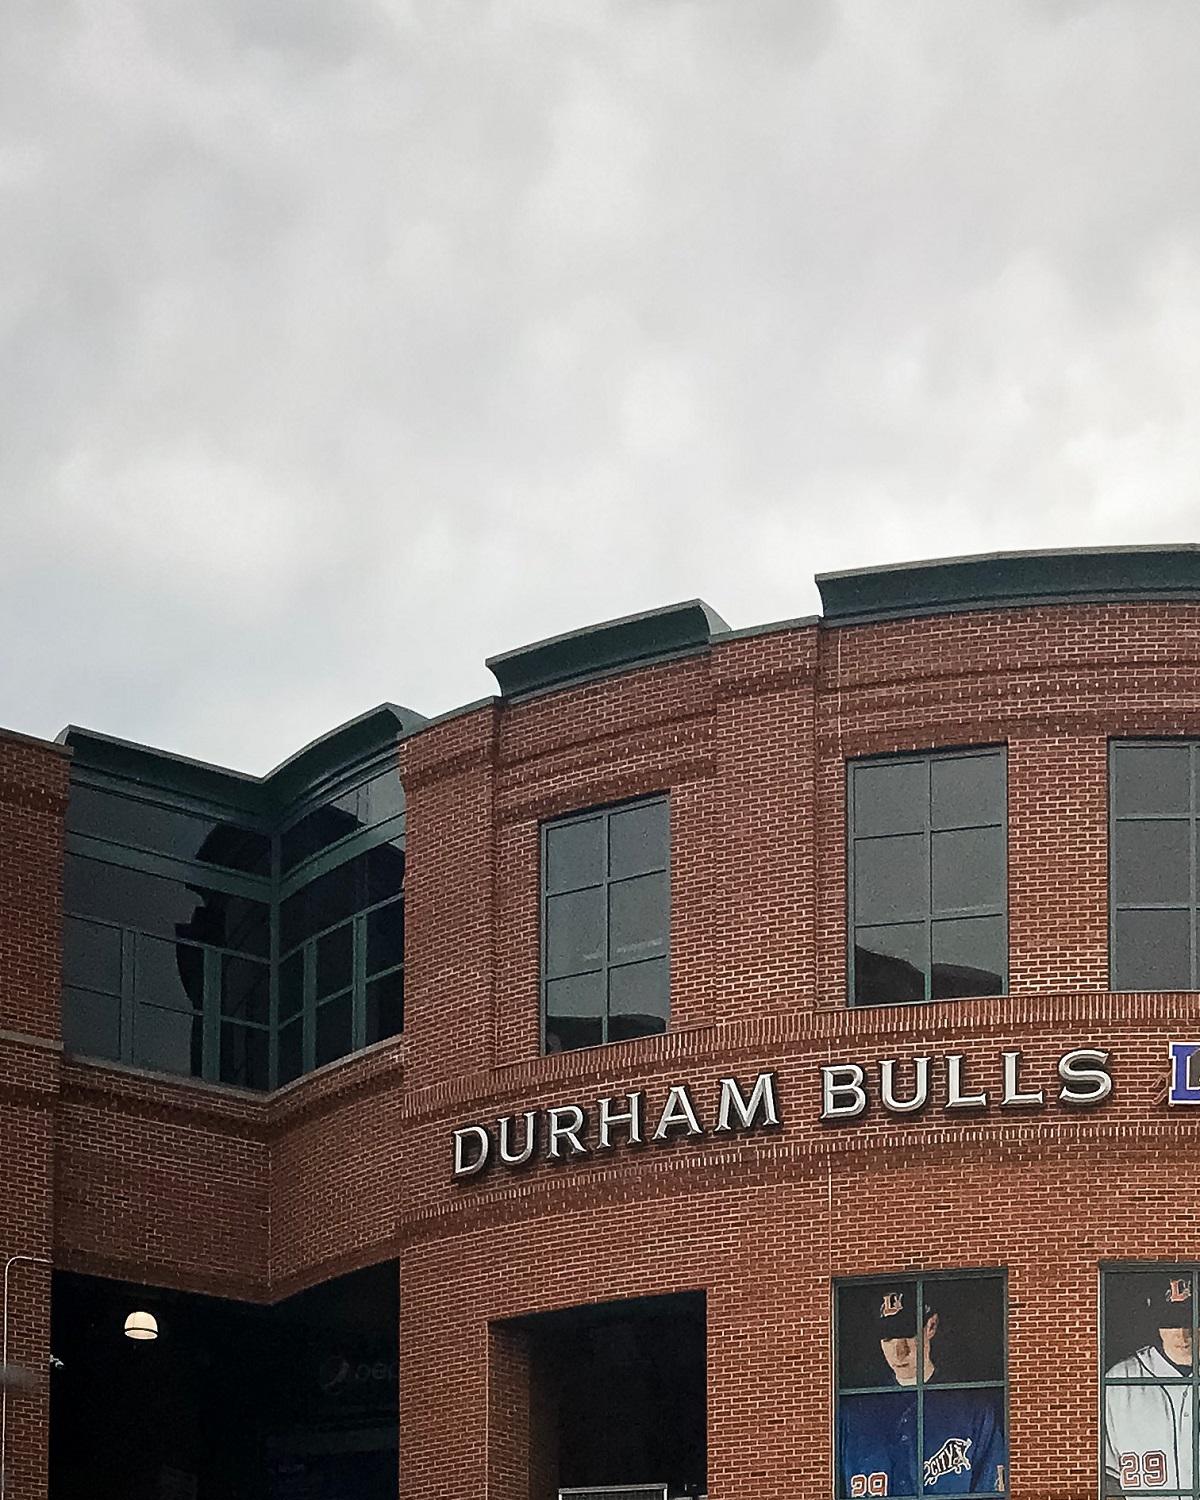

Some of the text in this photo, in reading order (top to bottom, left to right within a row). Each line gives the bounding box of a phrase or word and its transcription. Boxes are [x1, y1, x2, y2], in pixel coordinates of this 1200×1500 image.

[452, 1072, 780, 1178] DURHAM
[820, 1048, 1112, 1120] BULLS
[1120, 1450, 1167, 1488] 29
